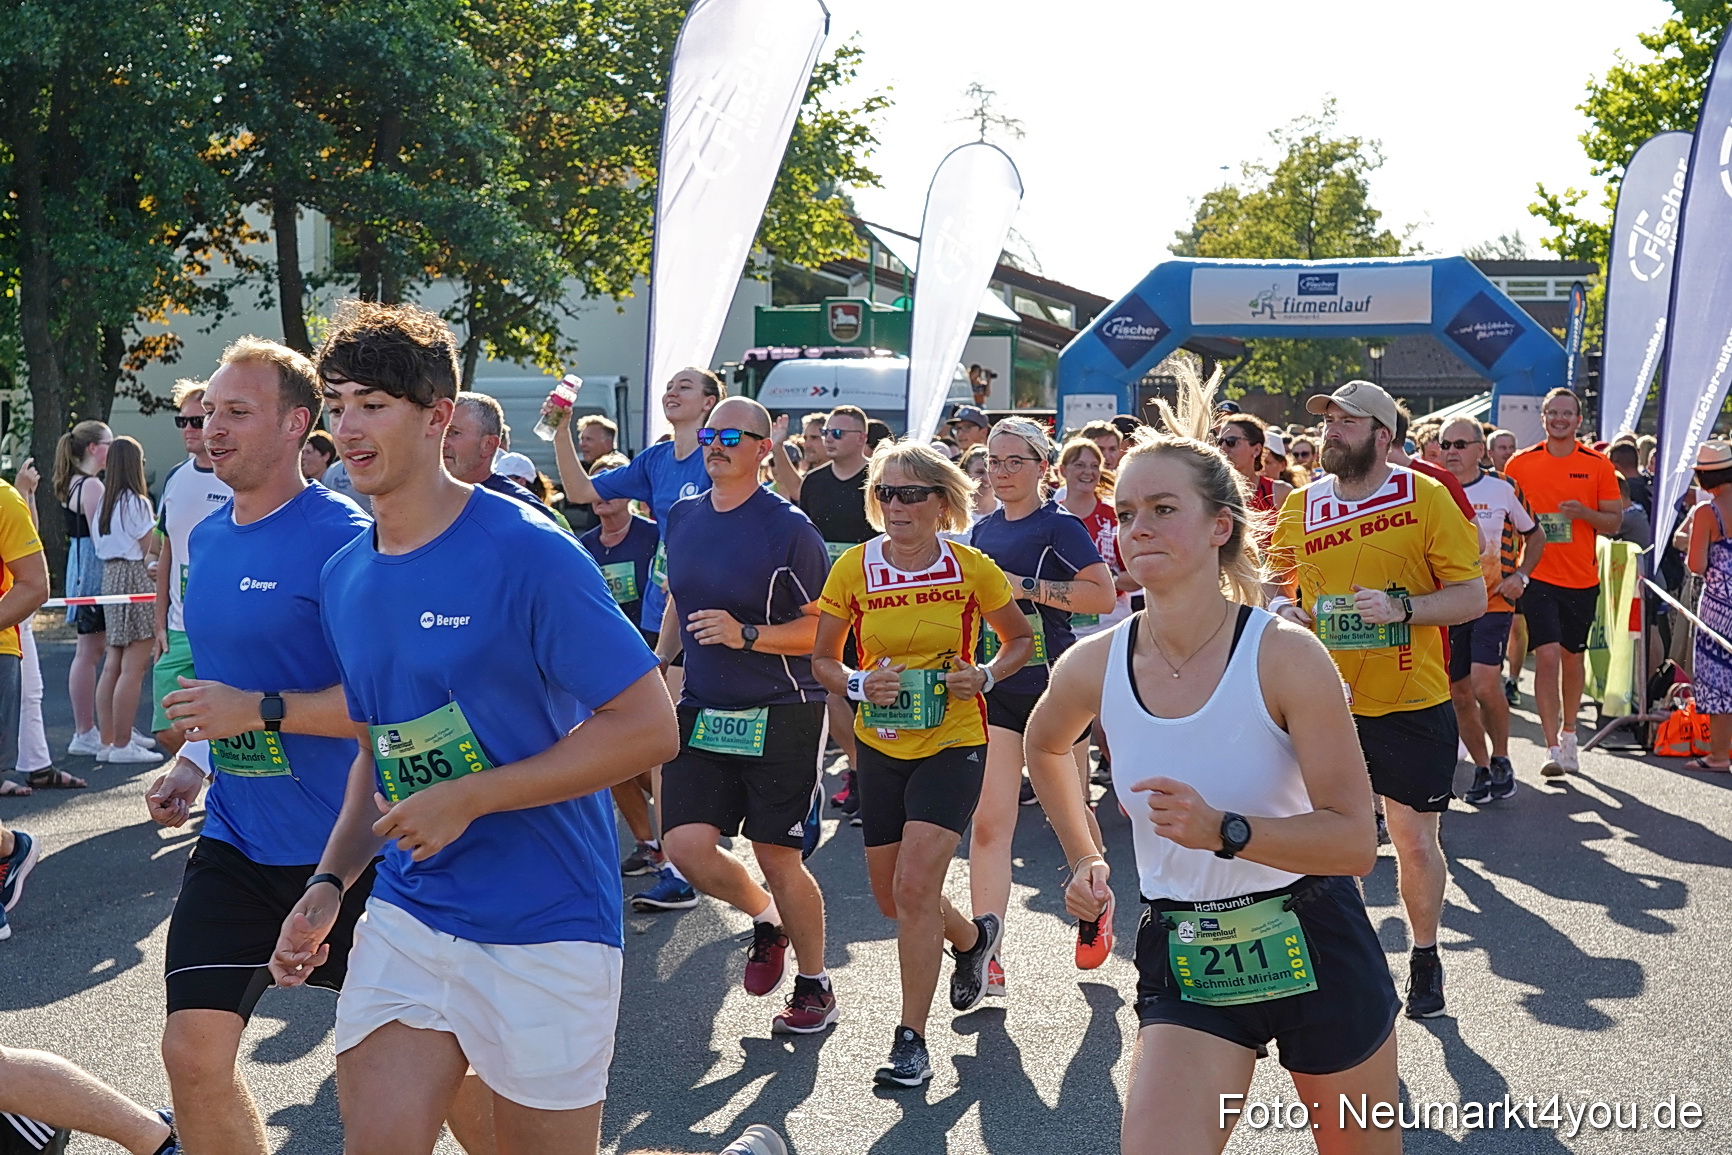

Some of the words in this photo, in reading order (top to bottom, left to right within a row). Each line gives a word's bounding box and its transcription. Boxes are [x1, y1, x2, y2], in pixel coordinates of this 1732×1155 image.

[1643, 157, 1687, 261] Fischer
[1283, 295, 1373, 314] firmenlauf
[1111, 324, 1160, 336] Fischer
[1304, 528, 1354, 556] MAX
[1359, 511, 1418, 537] BÖGL
[250, 579, 278, 592] Berger
[867, 594, 910, 610] MAX
[915, 588, 965, 605] BÖGL
[436, 614, 471, 629] Berger
[1033, 634, 1044, 658] 2022
[1351, 632, 1375, 640] Stefan
[889, 711, 913, 719] Barbara
[913, 693, 921, 721] 2022
[712, 716, 748, 737] 960
[753, 722, 763, 748] 2022
[241, 752, 267, 762] André
[399, 749, 453, 787] 456
[459, 741, 483, 773] 022
[383, 771, 400, 802] RUN
[1196, 928, 1237, 939] Firmenlauf
[1213, 934, 1237, 942] neumarkt
[1200, 939, 1269, 975] 211
[1285, 934, 1307, 980] 2022
[1177, 956, 1195, 987] RUN
[1193, 974, 1246, 990] Schmidt
[1248, 968, 1292, 985] Miriam
